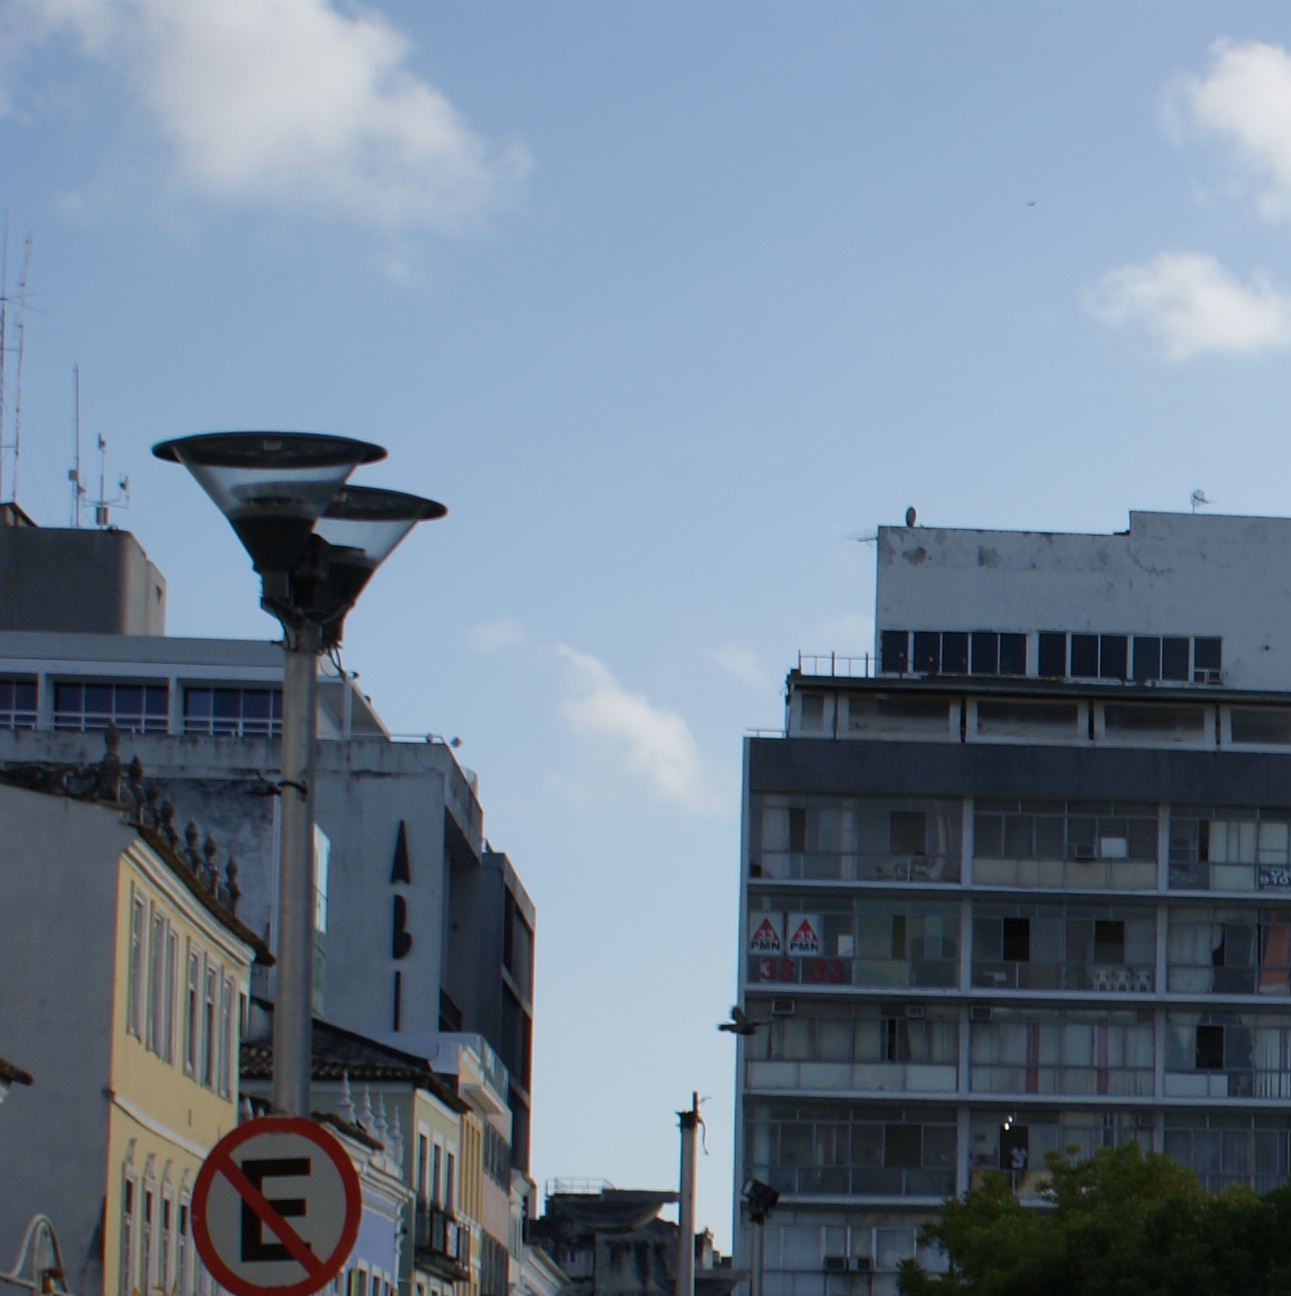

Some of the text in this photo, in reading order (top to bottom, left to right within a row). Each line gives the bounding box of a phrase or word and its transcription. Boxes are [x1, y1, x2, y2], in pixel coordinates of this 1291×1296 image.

[751, 940, 780, 951] PMN
[790, 942, 819, 952] PMN
[242, 1158, 311, 1262] E
